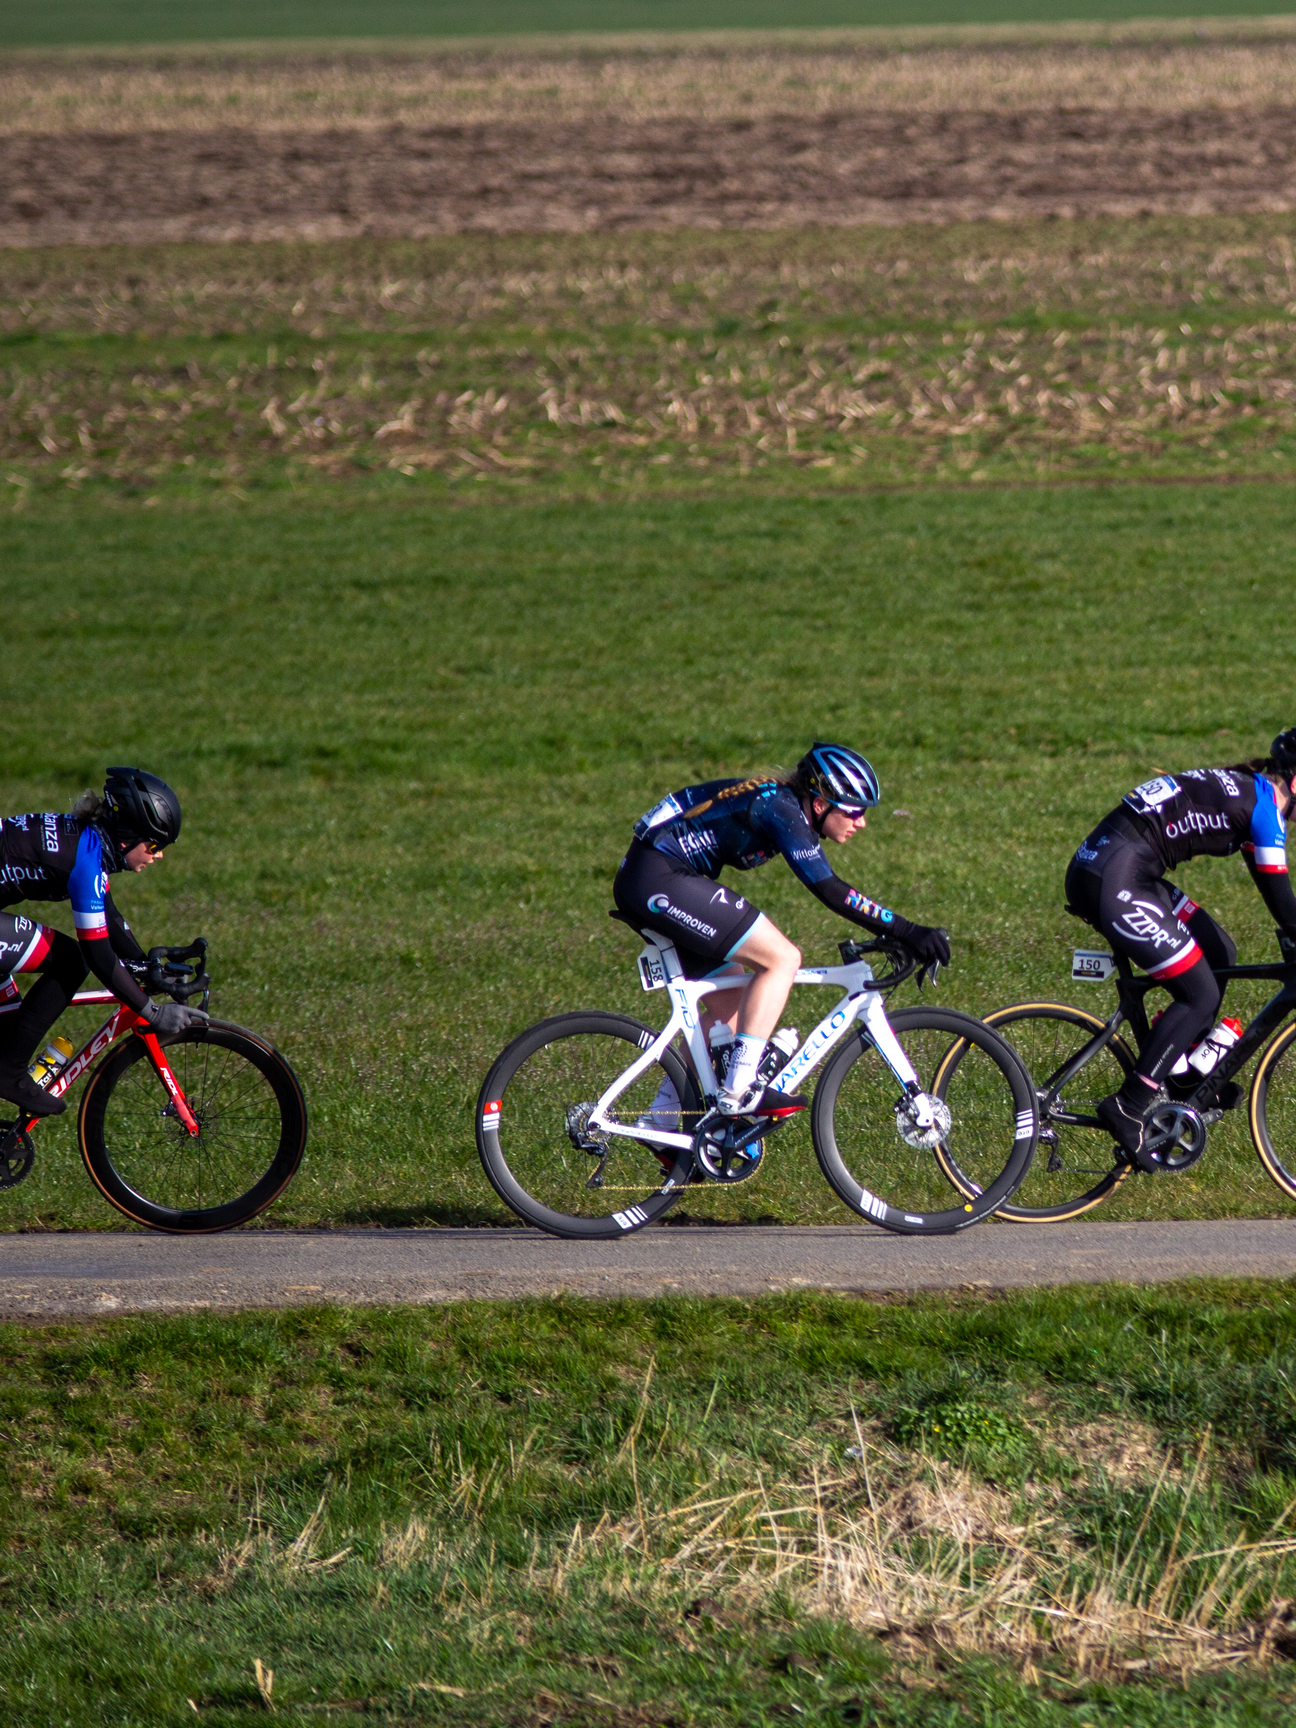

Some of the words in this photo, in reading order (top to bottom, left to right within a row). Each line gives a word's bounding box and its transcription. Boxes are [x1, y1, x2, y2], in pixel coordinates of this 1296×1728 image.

[1166, 810, 1231, 839] output
[667, 905, 717, 938] IMPROVEN
[649, 959, 664, 982] 158
[1078, 959, 1101, 971] 150
[48, 1014, 120, 1098] RIDLEY
